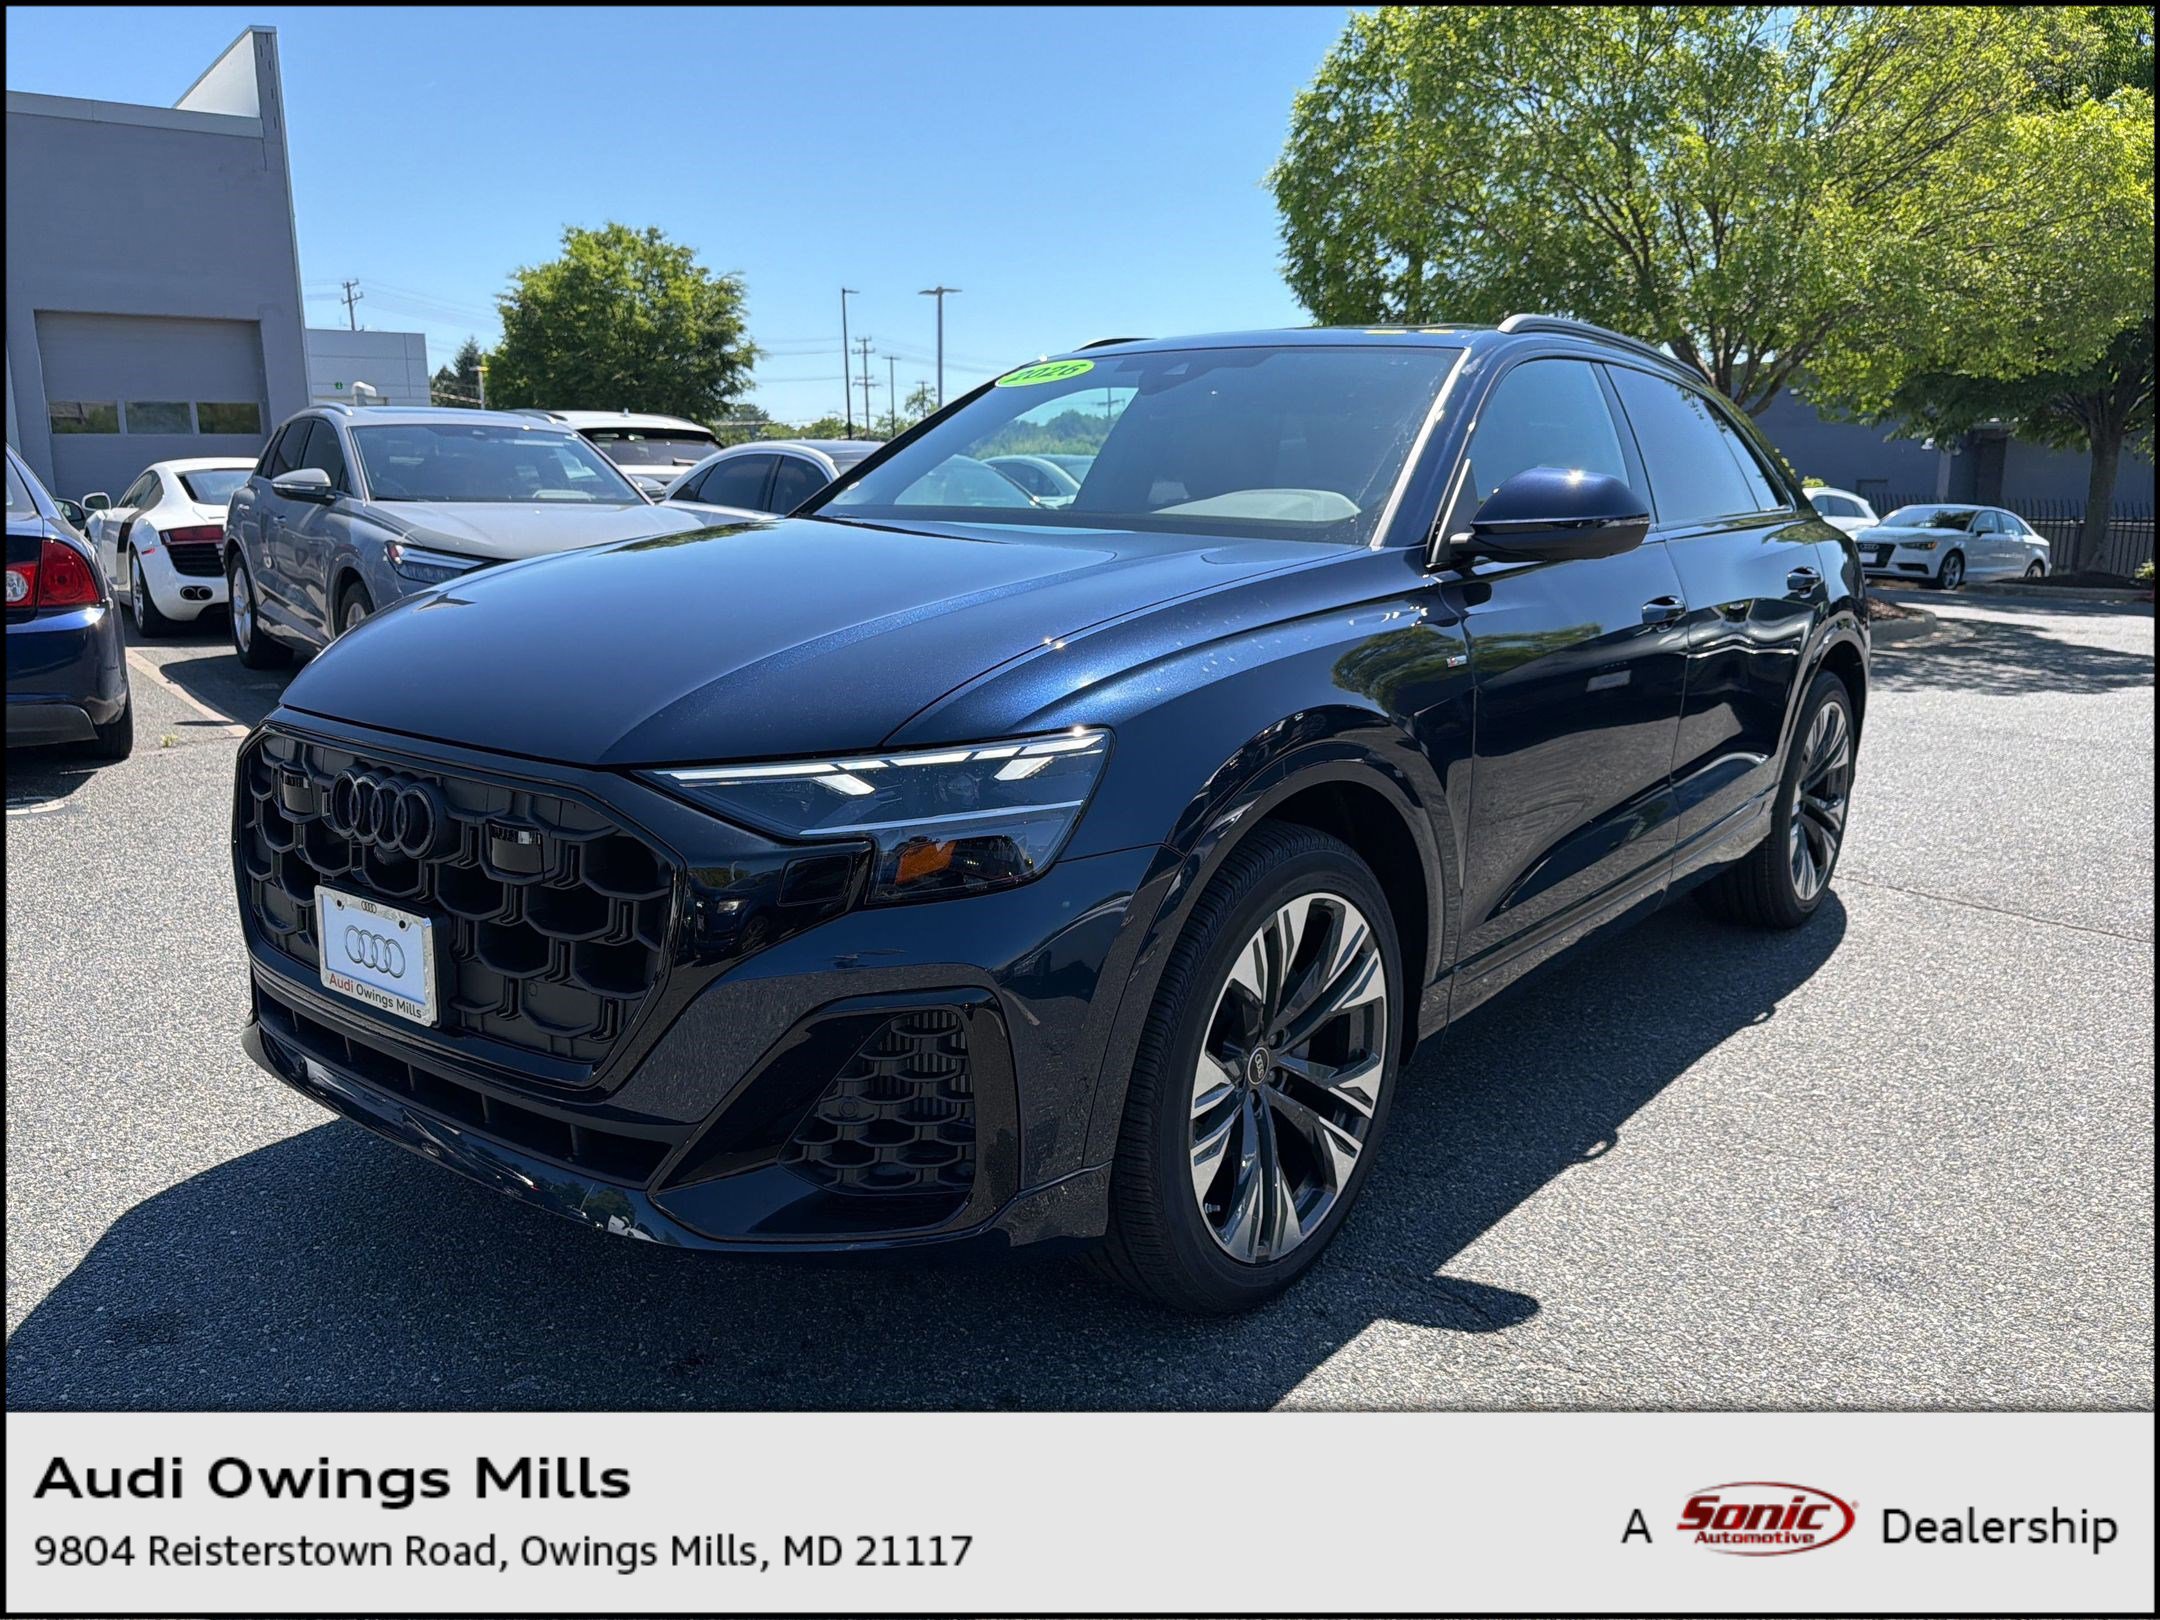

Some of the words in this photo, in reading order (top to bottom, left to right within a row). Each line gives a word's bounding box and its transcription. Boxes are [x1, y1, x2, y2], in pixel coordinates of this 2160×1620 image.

[1003, 363, 1088, 384] 2026
[329, 973, 354, 993] Audi
[356, 984, 394, 1009] Owings
[396, 998, 422, 1019] Mills
